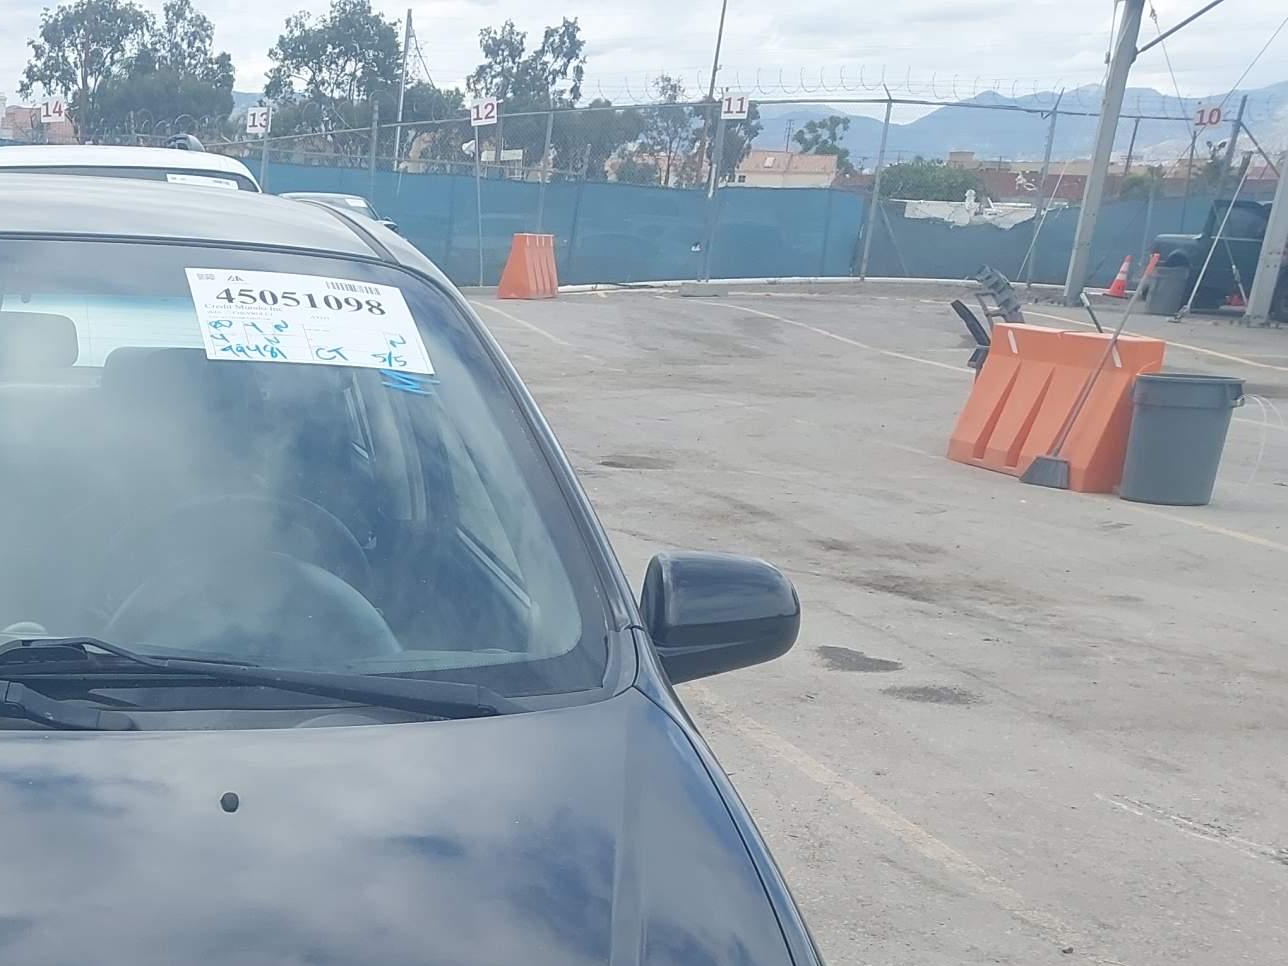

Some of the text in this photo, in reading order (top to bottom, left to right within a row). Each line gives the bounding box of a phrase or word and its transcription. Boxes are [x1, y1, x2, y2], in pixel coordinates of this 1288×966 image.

[42, 100, 64, 118] 14
[472, 102, 496, 121] 12
[723, 96, 747, 114] 11
[248, 111, 268, 129] 13
[1194, 107, 1222, 126] 10
[215, 287, 387, 316] 45051098
